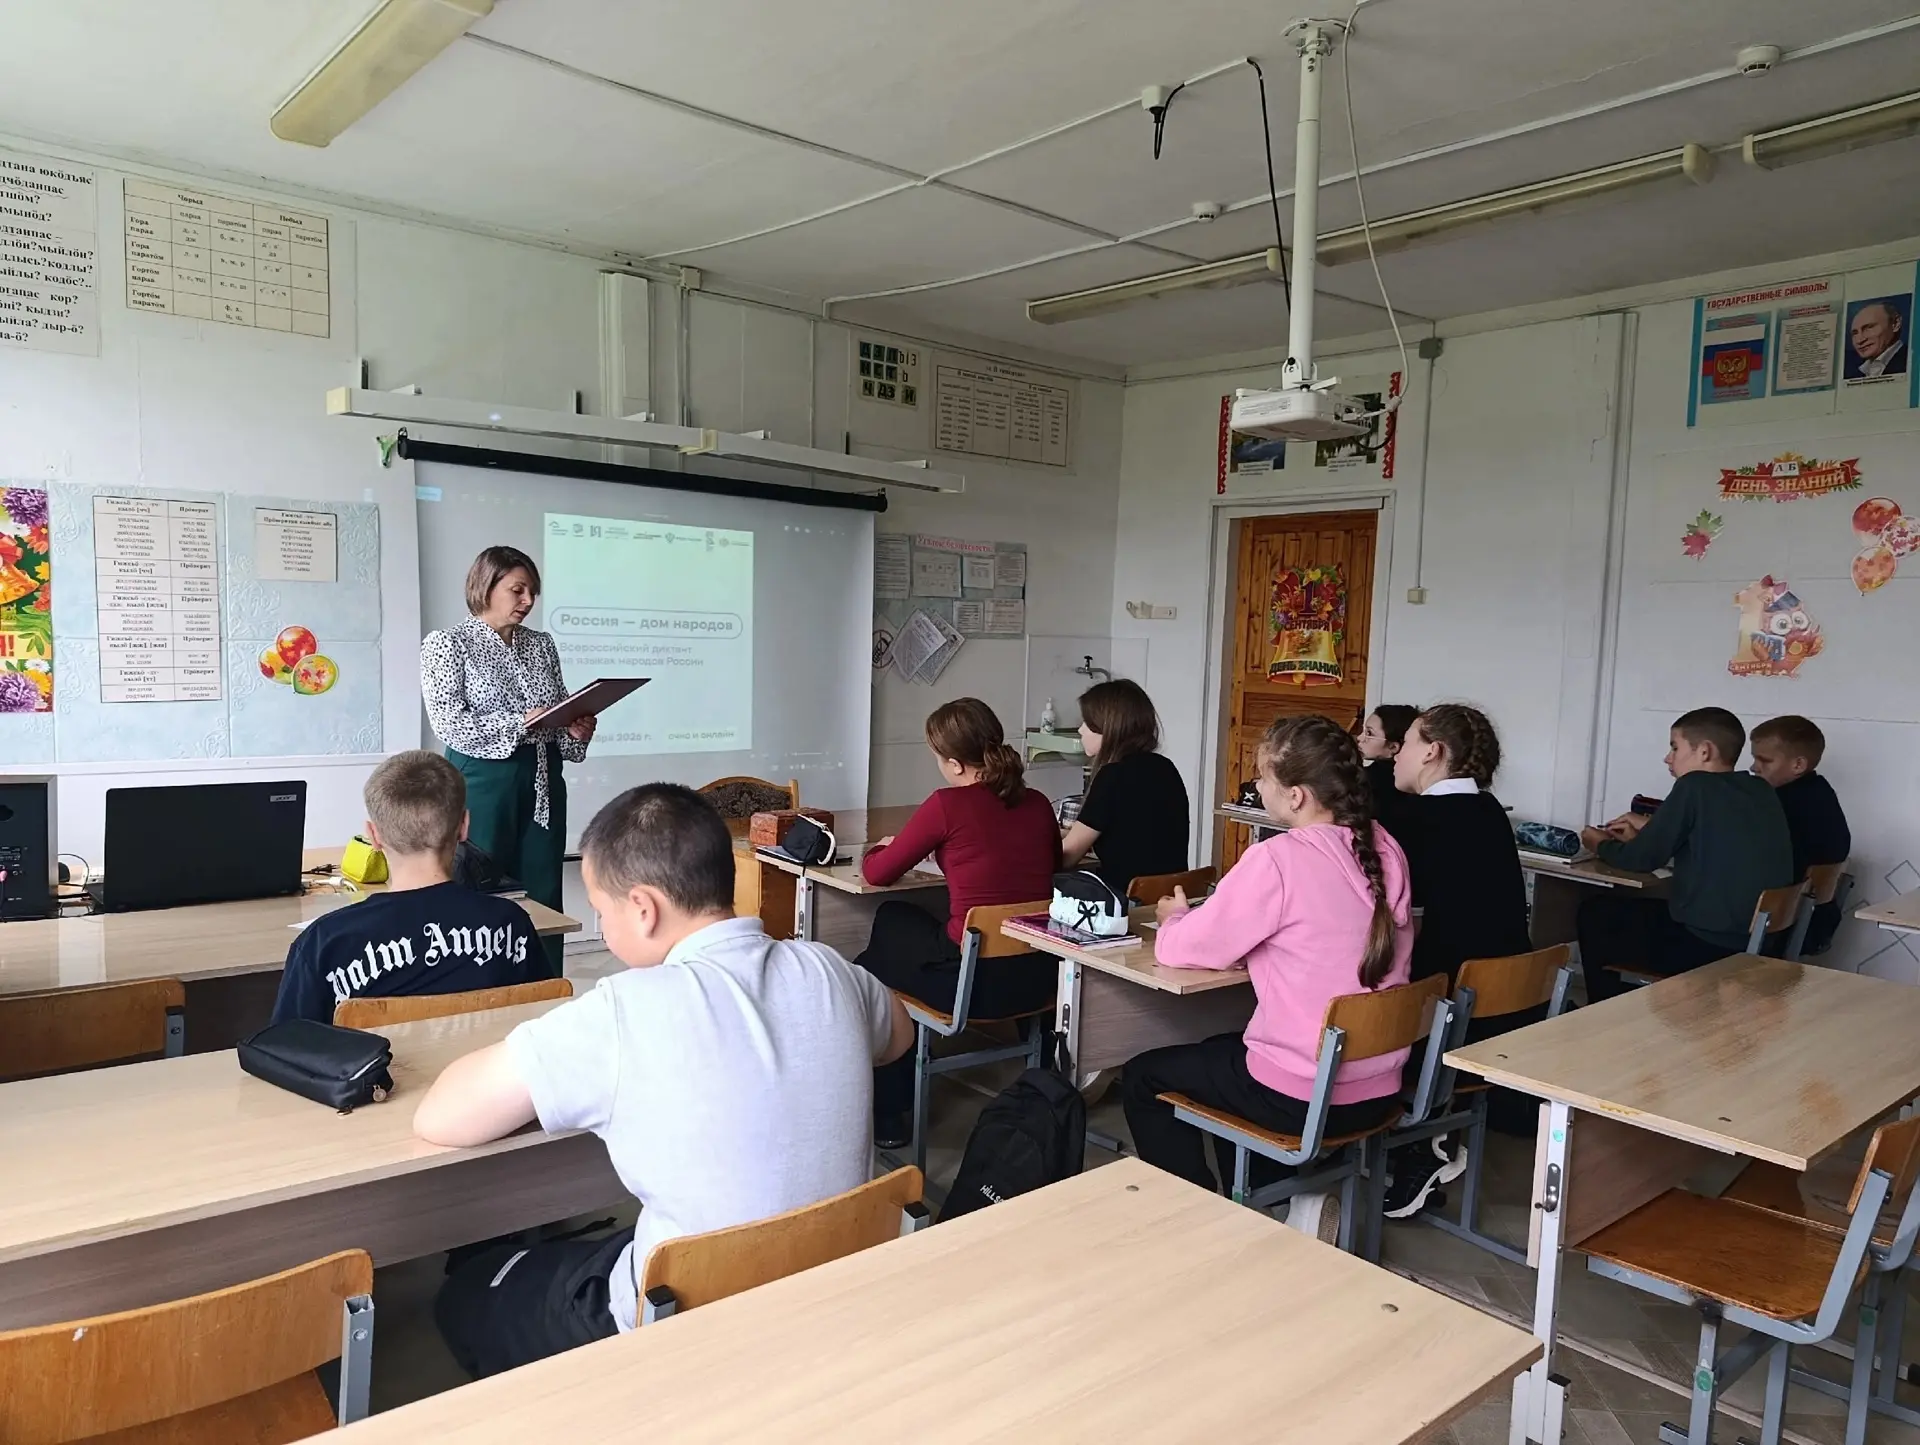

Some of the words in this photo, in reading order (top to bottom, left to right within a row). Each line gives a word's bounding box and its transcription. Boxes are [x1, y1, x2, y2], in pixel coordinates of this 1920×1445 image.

[50, 294, 78, 304] кор?
[1707, 290, 1782, 308] ГОСУДАРСТВЕННЫЕ
[1785, 282, 1828, 297] СИМВОЛЫ
[1728, 478, 1770, 492] ДЕНЬ
[1774, 470, 1846, 492] ЗНАНИЙ
[560, 614, 619, 627] Россия
[640, 618, 668, 631] дом
[674, 619, 733, 632] народов
[560, 642, 649, 654] Всероссийский
[652, 645, 692, 654] диктант
[576, 657, 615, 666] языках
[618, 658, 664, 666] народов
[666, 657, 703, 666] России
[592, 734, 614, 744] бря
[423, 922, 528, 967] Angels
